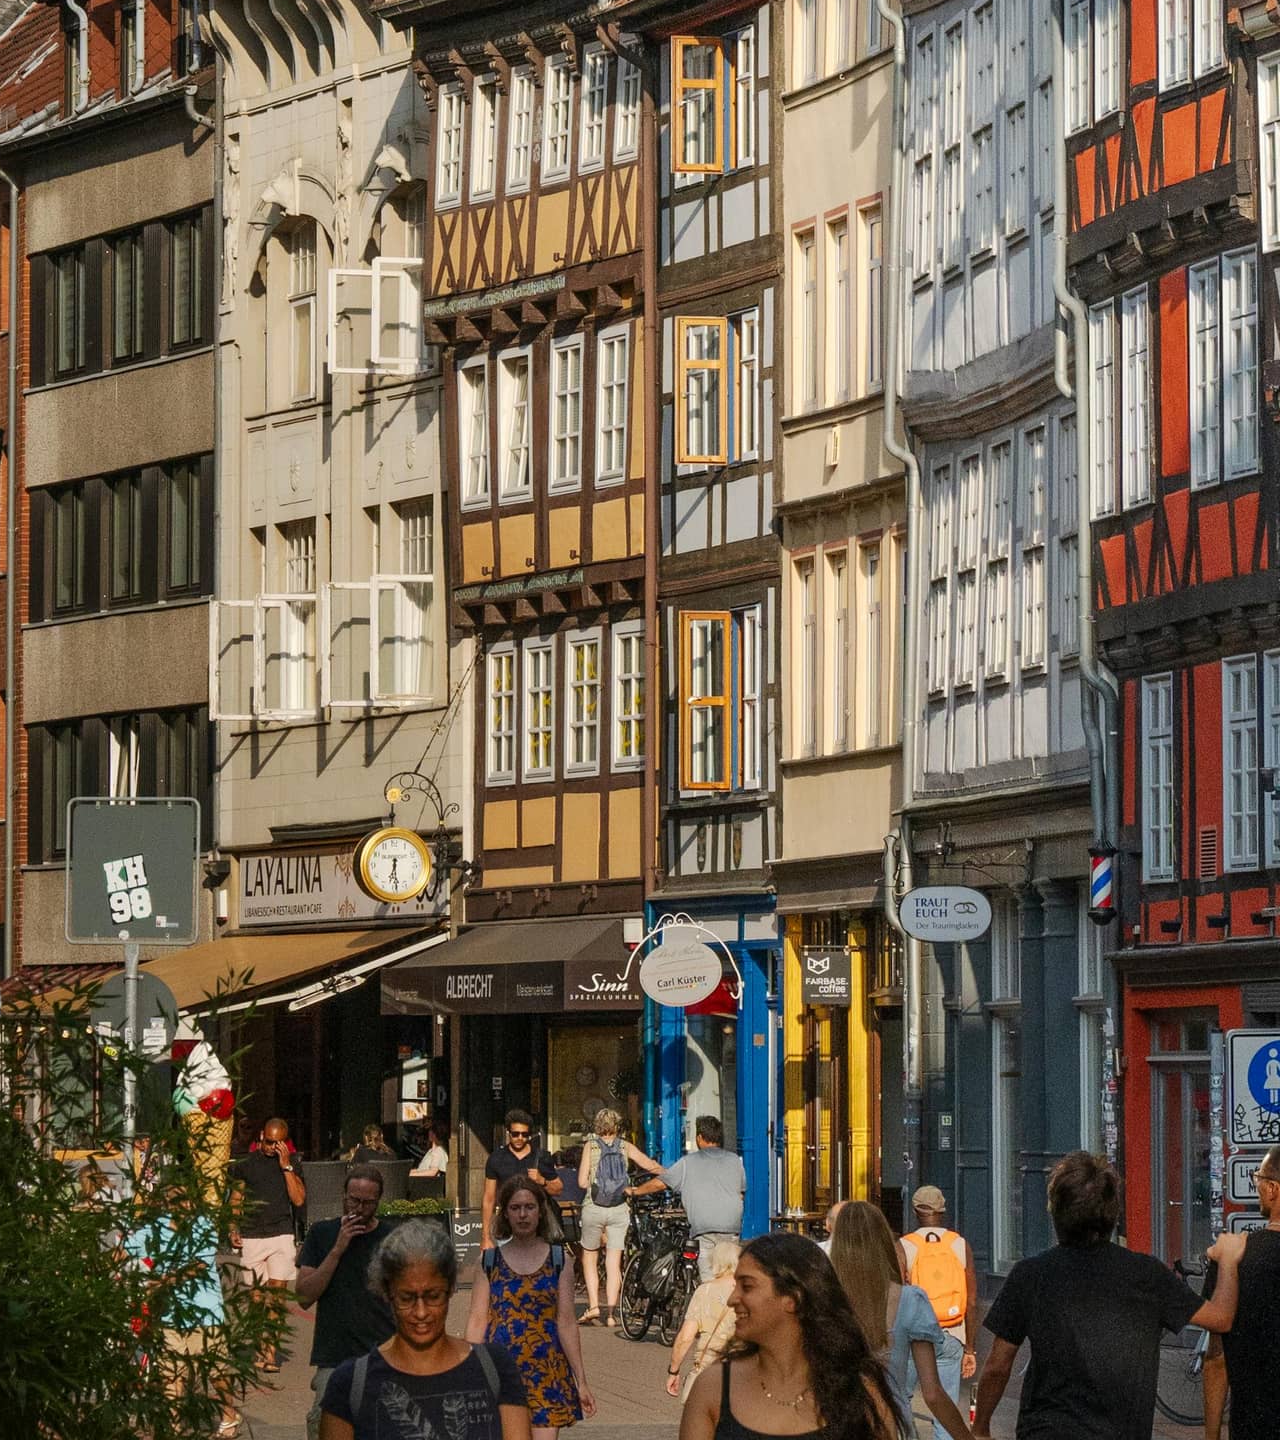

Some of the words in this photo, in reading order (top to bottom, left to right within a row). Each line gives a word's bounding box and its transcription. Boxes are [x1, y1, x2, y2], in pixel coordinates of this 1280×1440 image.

[104, 855, 148, 892] KH
[245, 855, 322, 896] LAYALINA
[109, 887, 152, 923] 98
[915, 898, 949, 907] TRAUT
[915, 908, 948, 918] EUCH
[446, 974, 494, 999] ALBRECHT
[578, 973, 628, 992] Sinn
[657, 979, 674, 988] Carl
[678, 975, 706, 985] Küster
[819, 983, 846, 993] coffee
